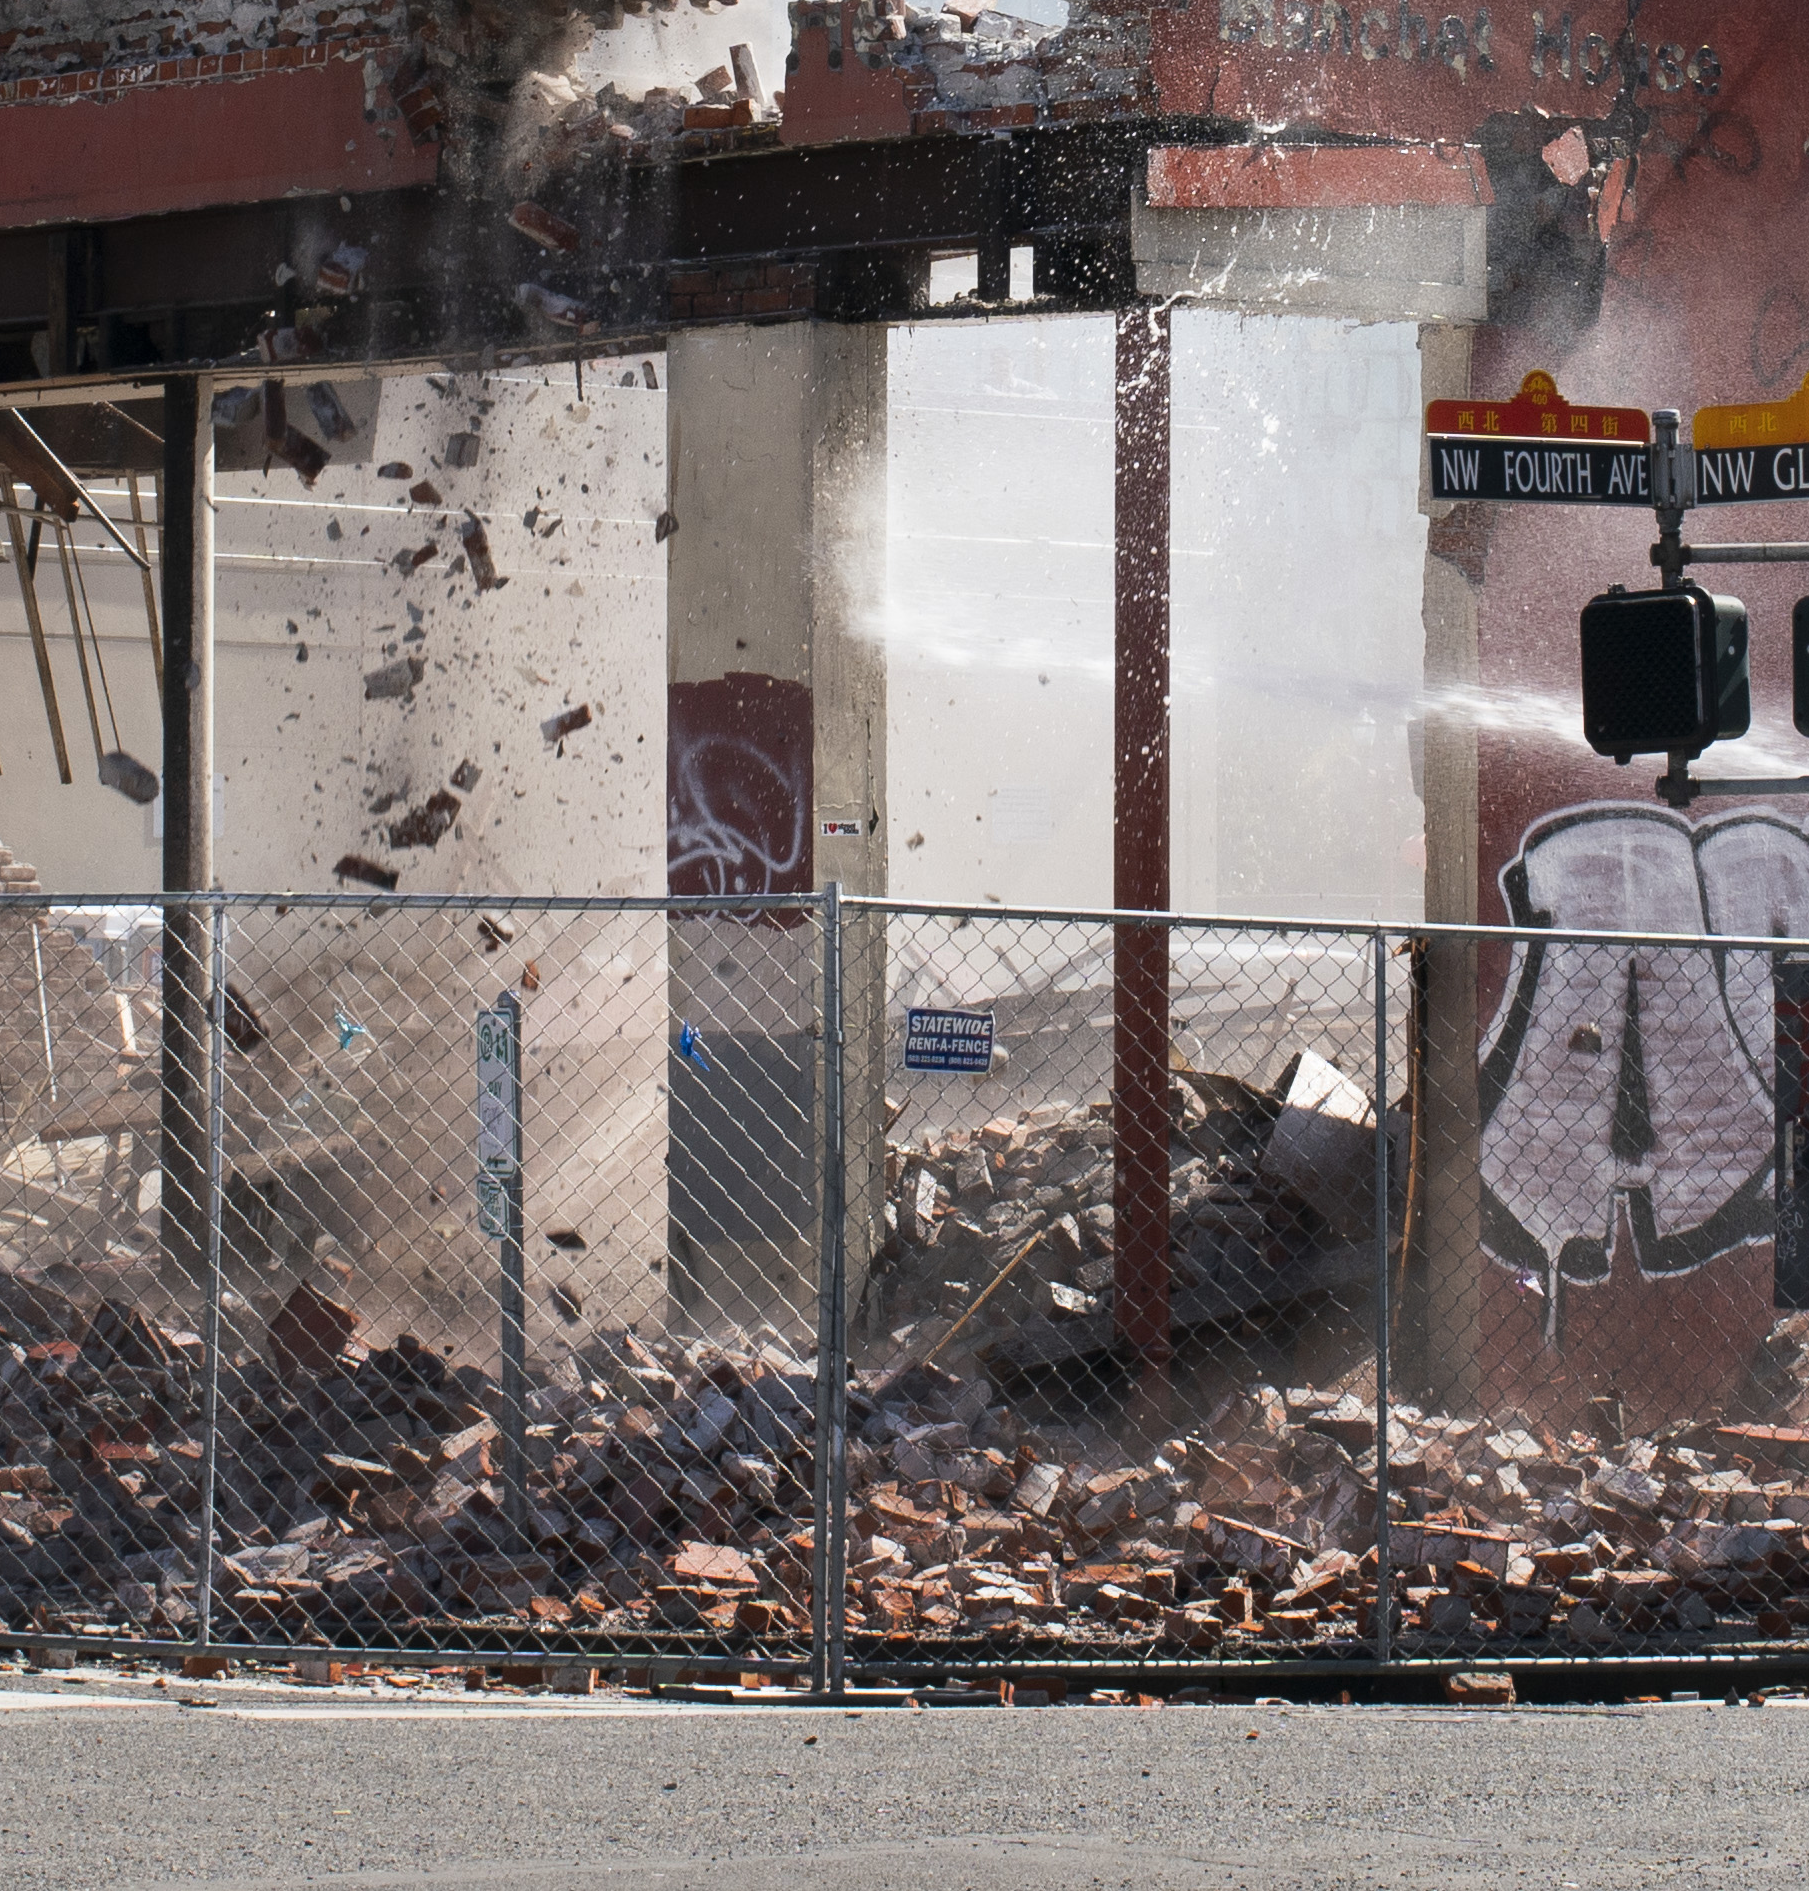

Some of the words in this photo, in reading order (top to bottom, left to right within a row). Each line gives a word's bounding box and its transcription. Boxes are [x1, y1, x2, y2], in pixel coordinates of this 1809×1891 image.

[1531, 393, 1548, 405] 400
[1457, 410, 1500, 432] 西北
[1541, 413, 1620, 437] 第四街
[1728, 412, 1777, 435] 西北
[1441, 449, 1480, 491] NW
[1503, 450, 1592, 494] FOURTH
[1607, 454, 1649, 496] AVE
[1701, 451, 1755, 496] NW
[911, 1014, 992, 1036] STATEWIDE
[908, 1036, 990, 1055] RENT-A-FENCE
